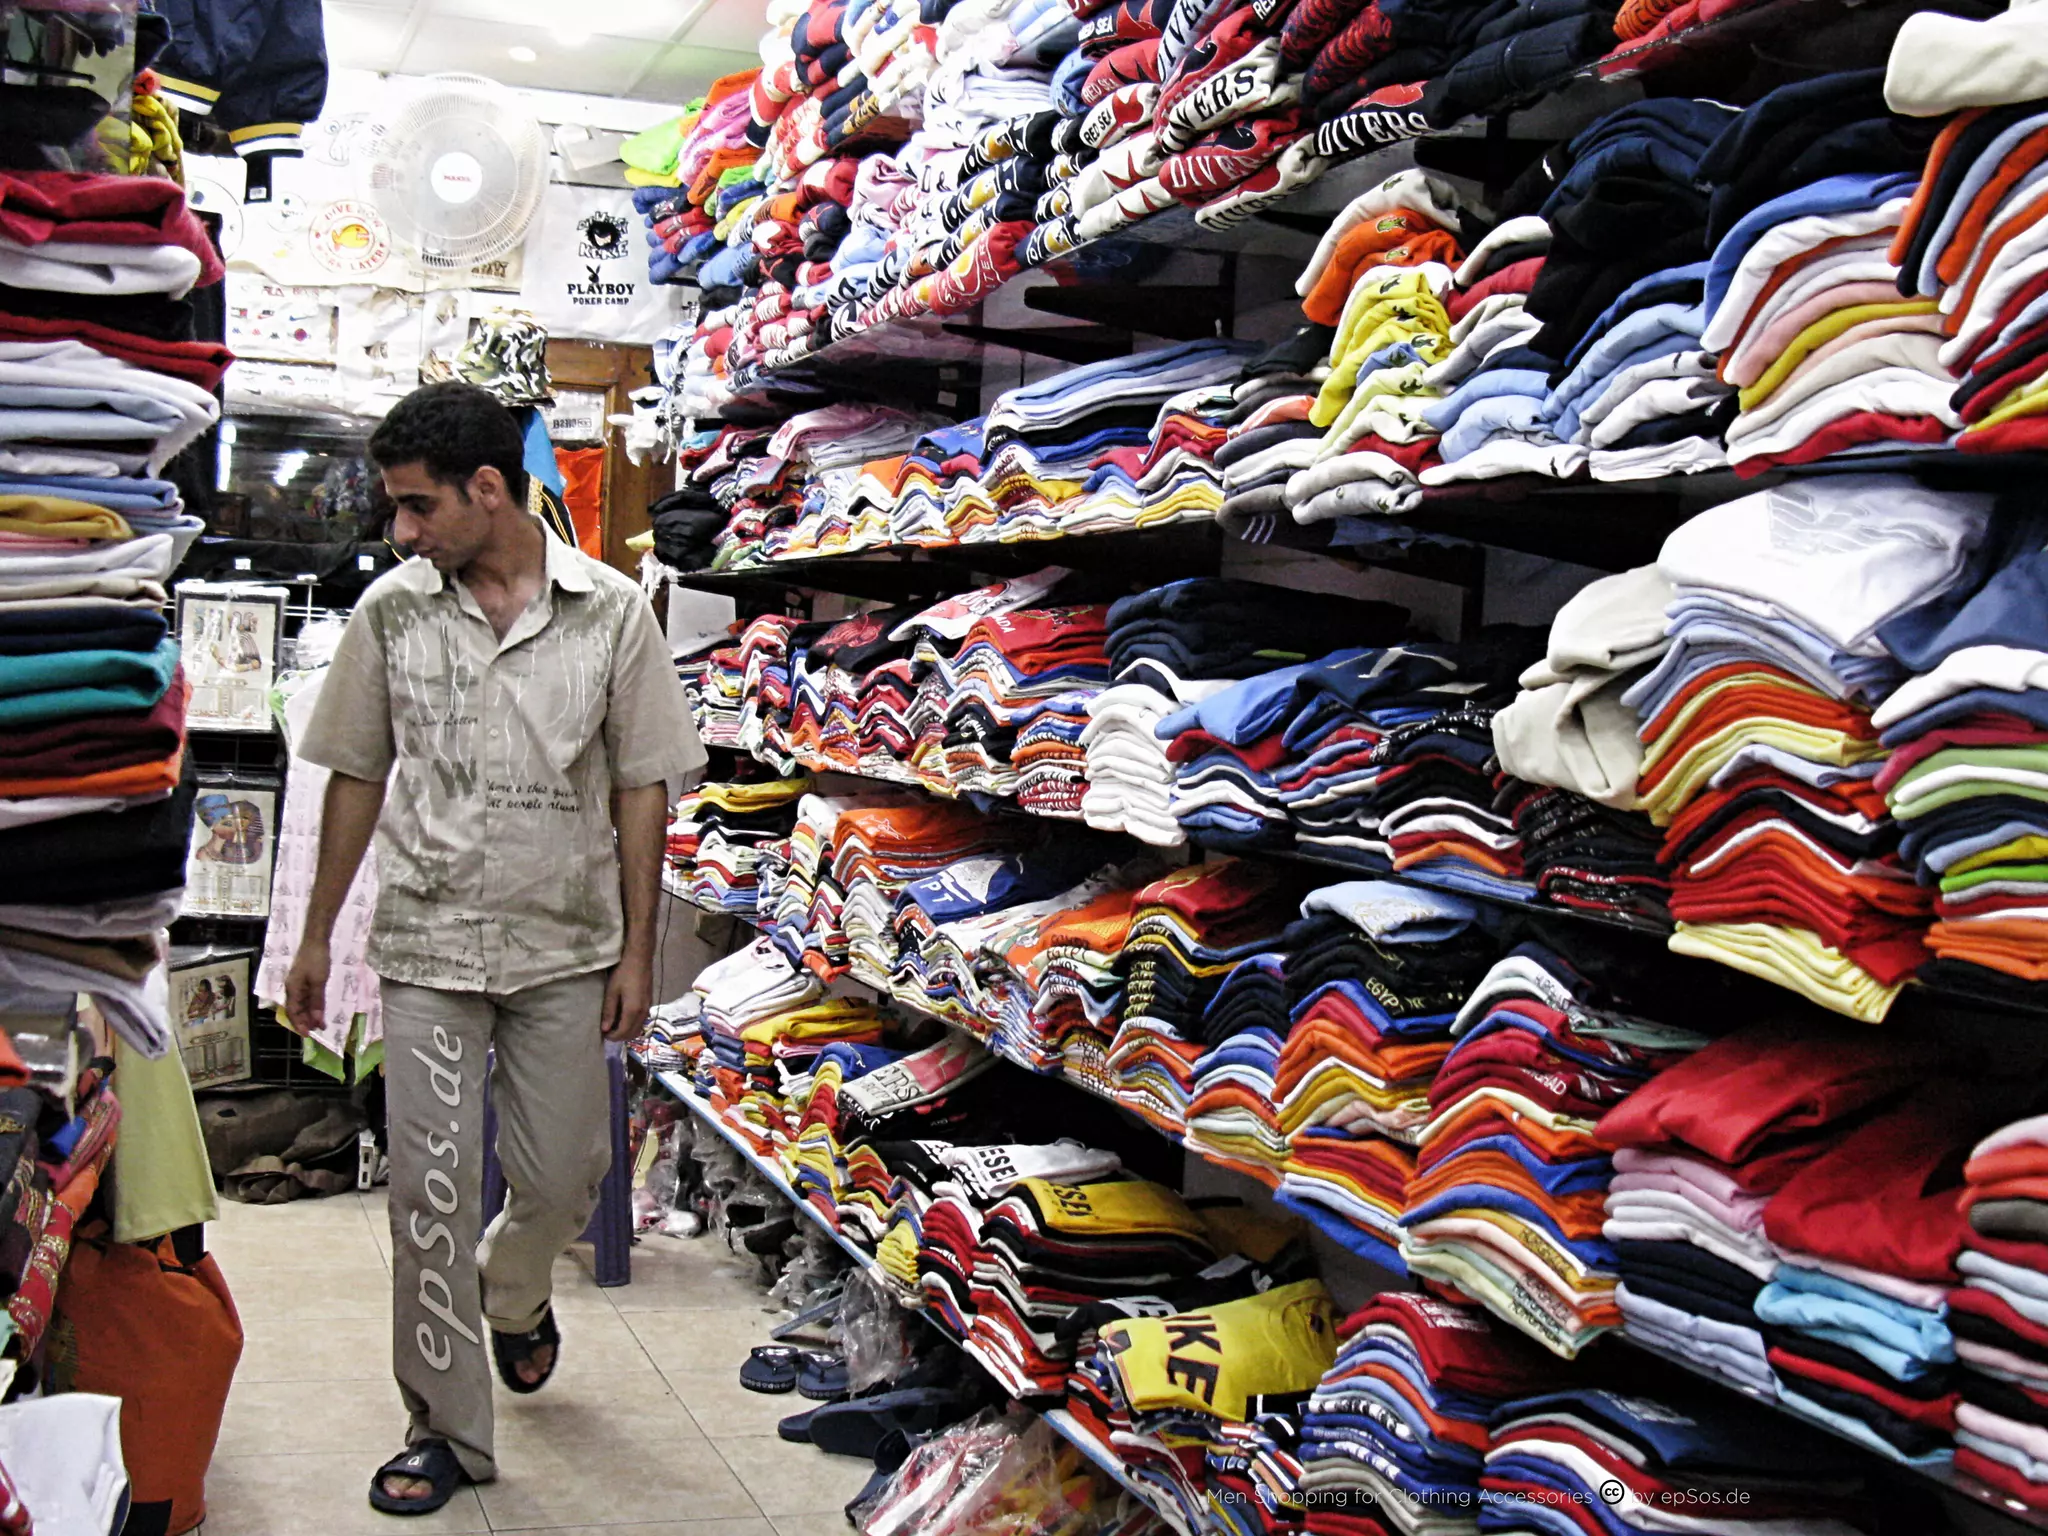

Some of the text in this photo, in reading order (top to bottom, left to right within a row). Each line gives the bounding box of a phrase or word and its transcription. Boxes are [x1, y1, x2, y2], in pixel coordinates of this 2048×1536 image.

[1083, 123, 1101, 145] RED
[1318, 111, 1436, 156] DIVERS
[350, 248, 384, 271] LATER
[567, 283, 636, 295] PLAYBOY
[573, 297, 630, 306] POKER CAMP
